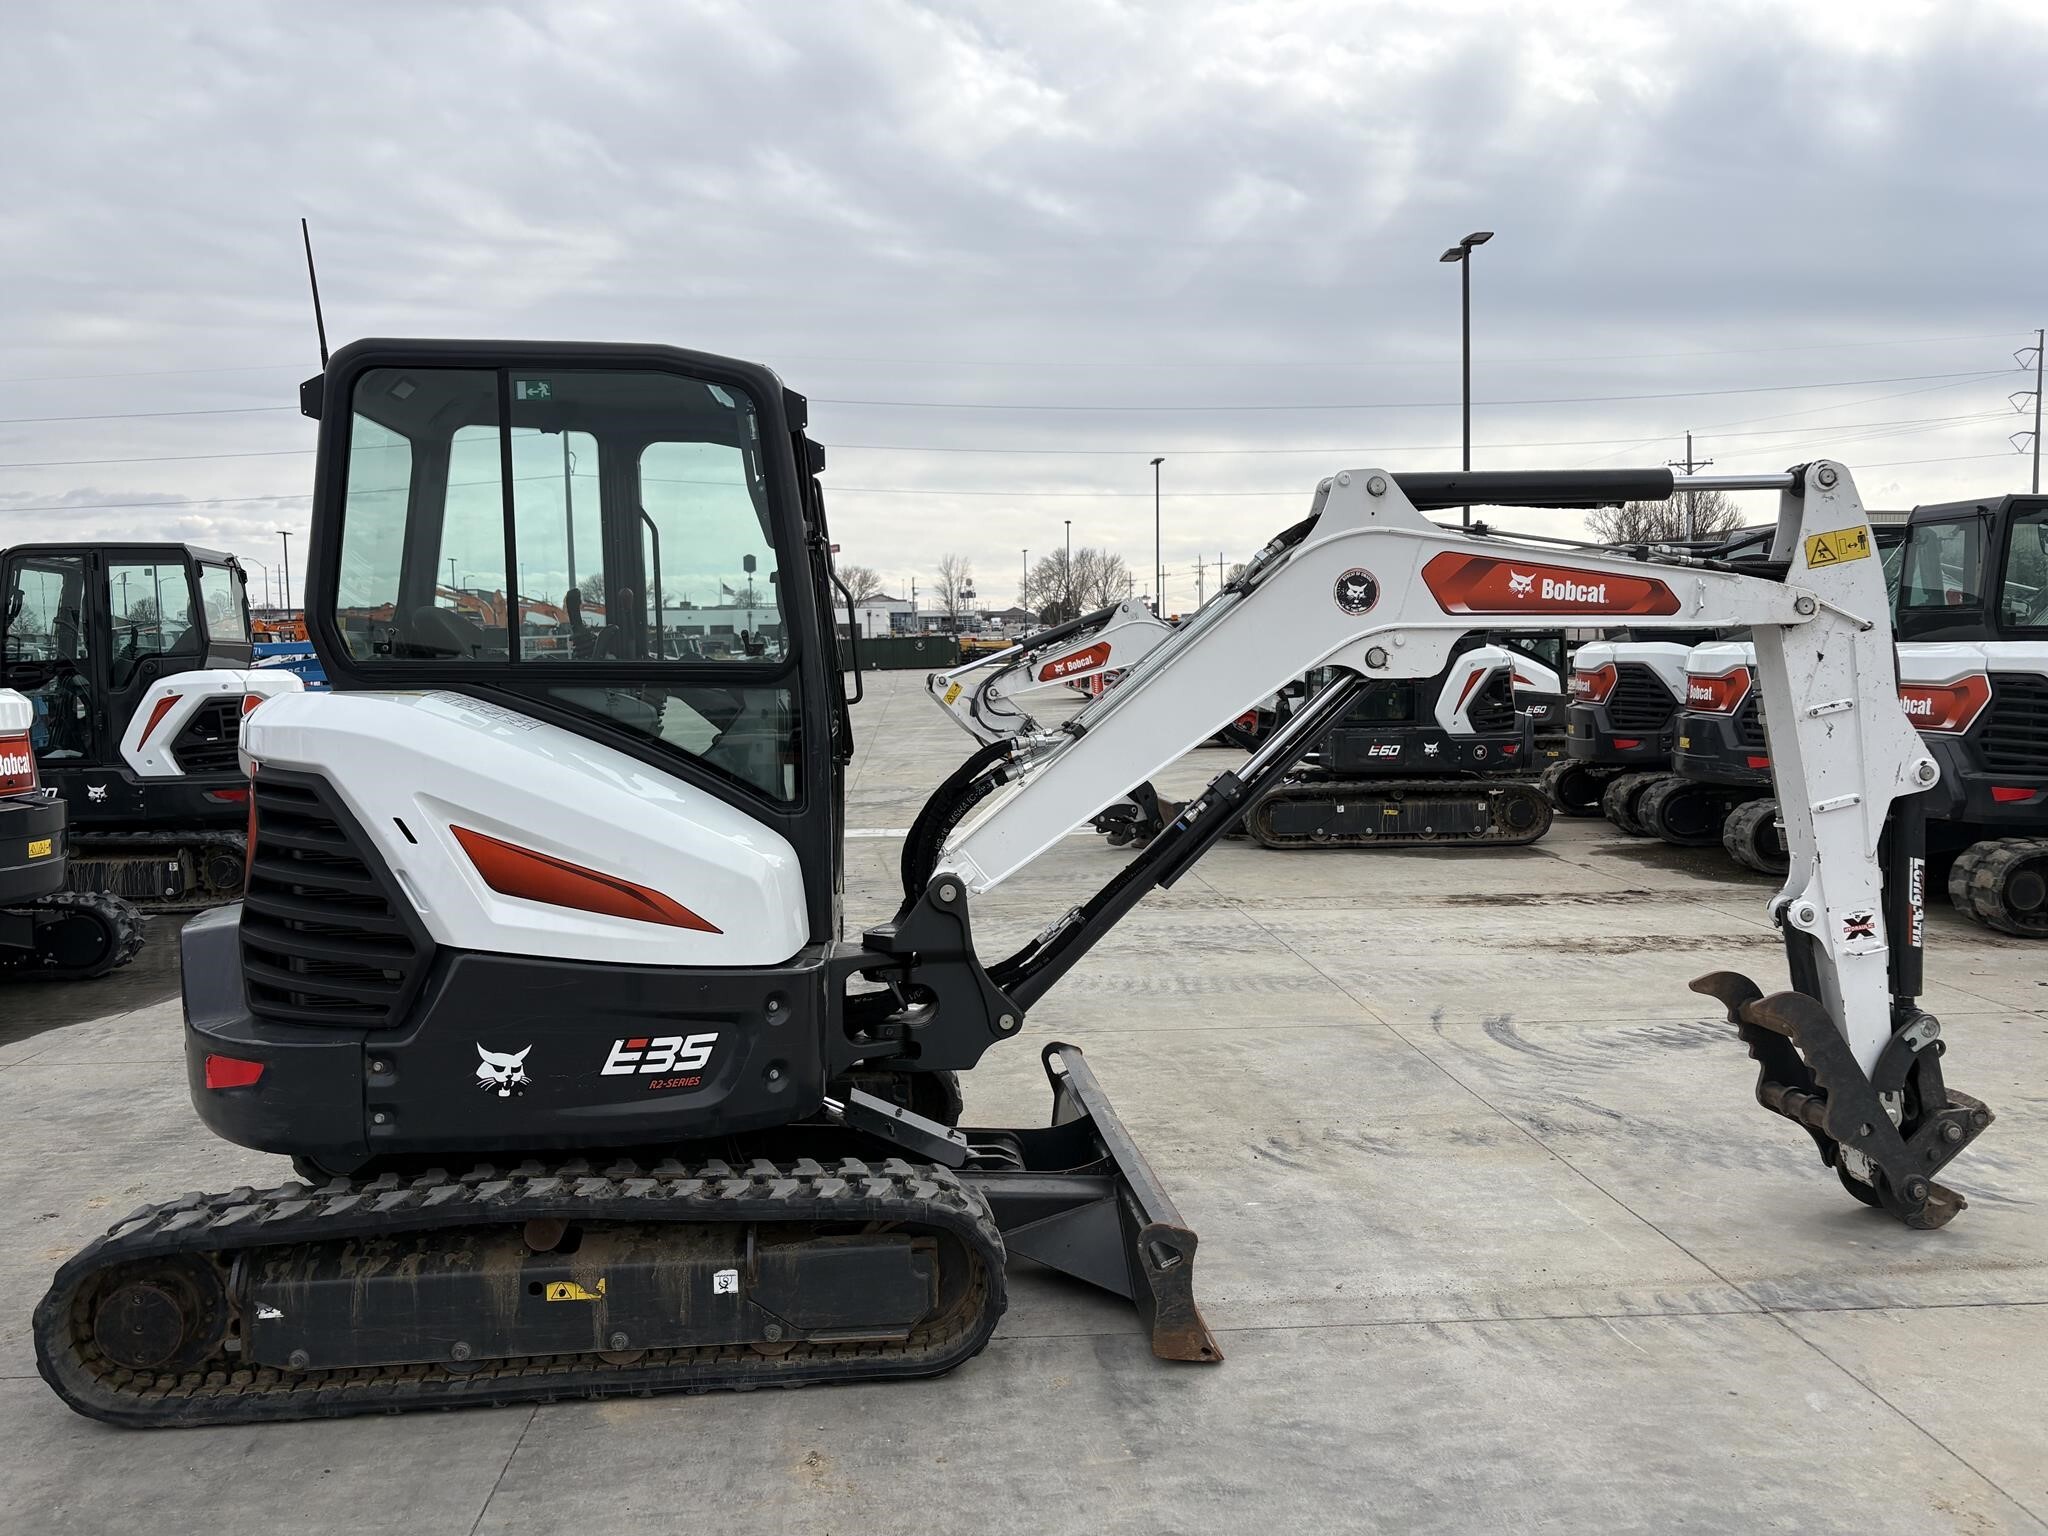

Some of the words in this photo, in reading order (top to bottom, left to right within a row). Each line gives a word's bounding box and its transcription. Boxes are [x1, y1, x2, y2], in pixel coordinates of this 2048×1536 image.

[1541, 578, 1606, 604] Bobcat
[1067, 655, 1094, 671] Bobcat
[1689, 684, 1713, 701] Bobcat
[1526, 705, 1548, 714] E60
[1899, 695, 1932, 715] bcat
[1367, 744, 1401, 756] E60
[600, 1032, 719, 1076] E35
[649, 1076, 702, 1090] R2-SERIES
